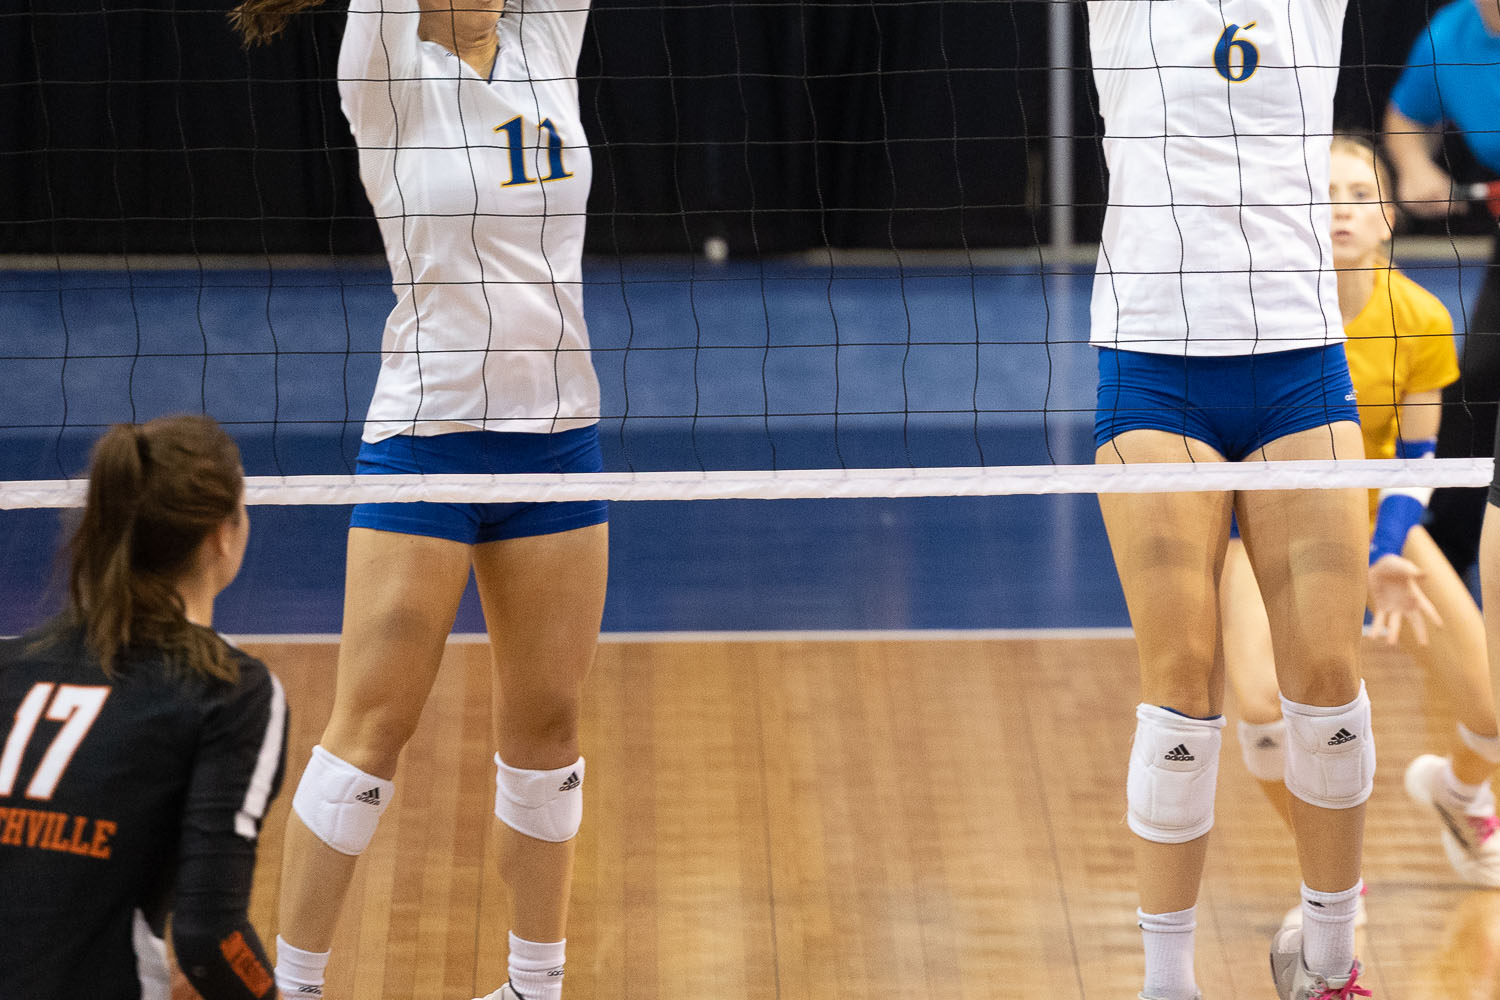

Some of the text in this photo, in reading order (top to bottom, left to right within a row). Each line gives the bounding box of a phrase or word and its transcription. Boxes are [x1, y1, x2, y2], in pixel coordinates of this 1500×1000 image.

[1211, 20, 1261, 84] 6
[492, 113, 576, 188] 11
[0, 682, 112, 800] 17
